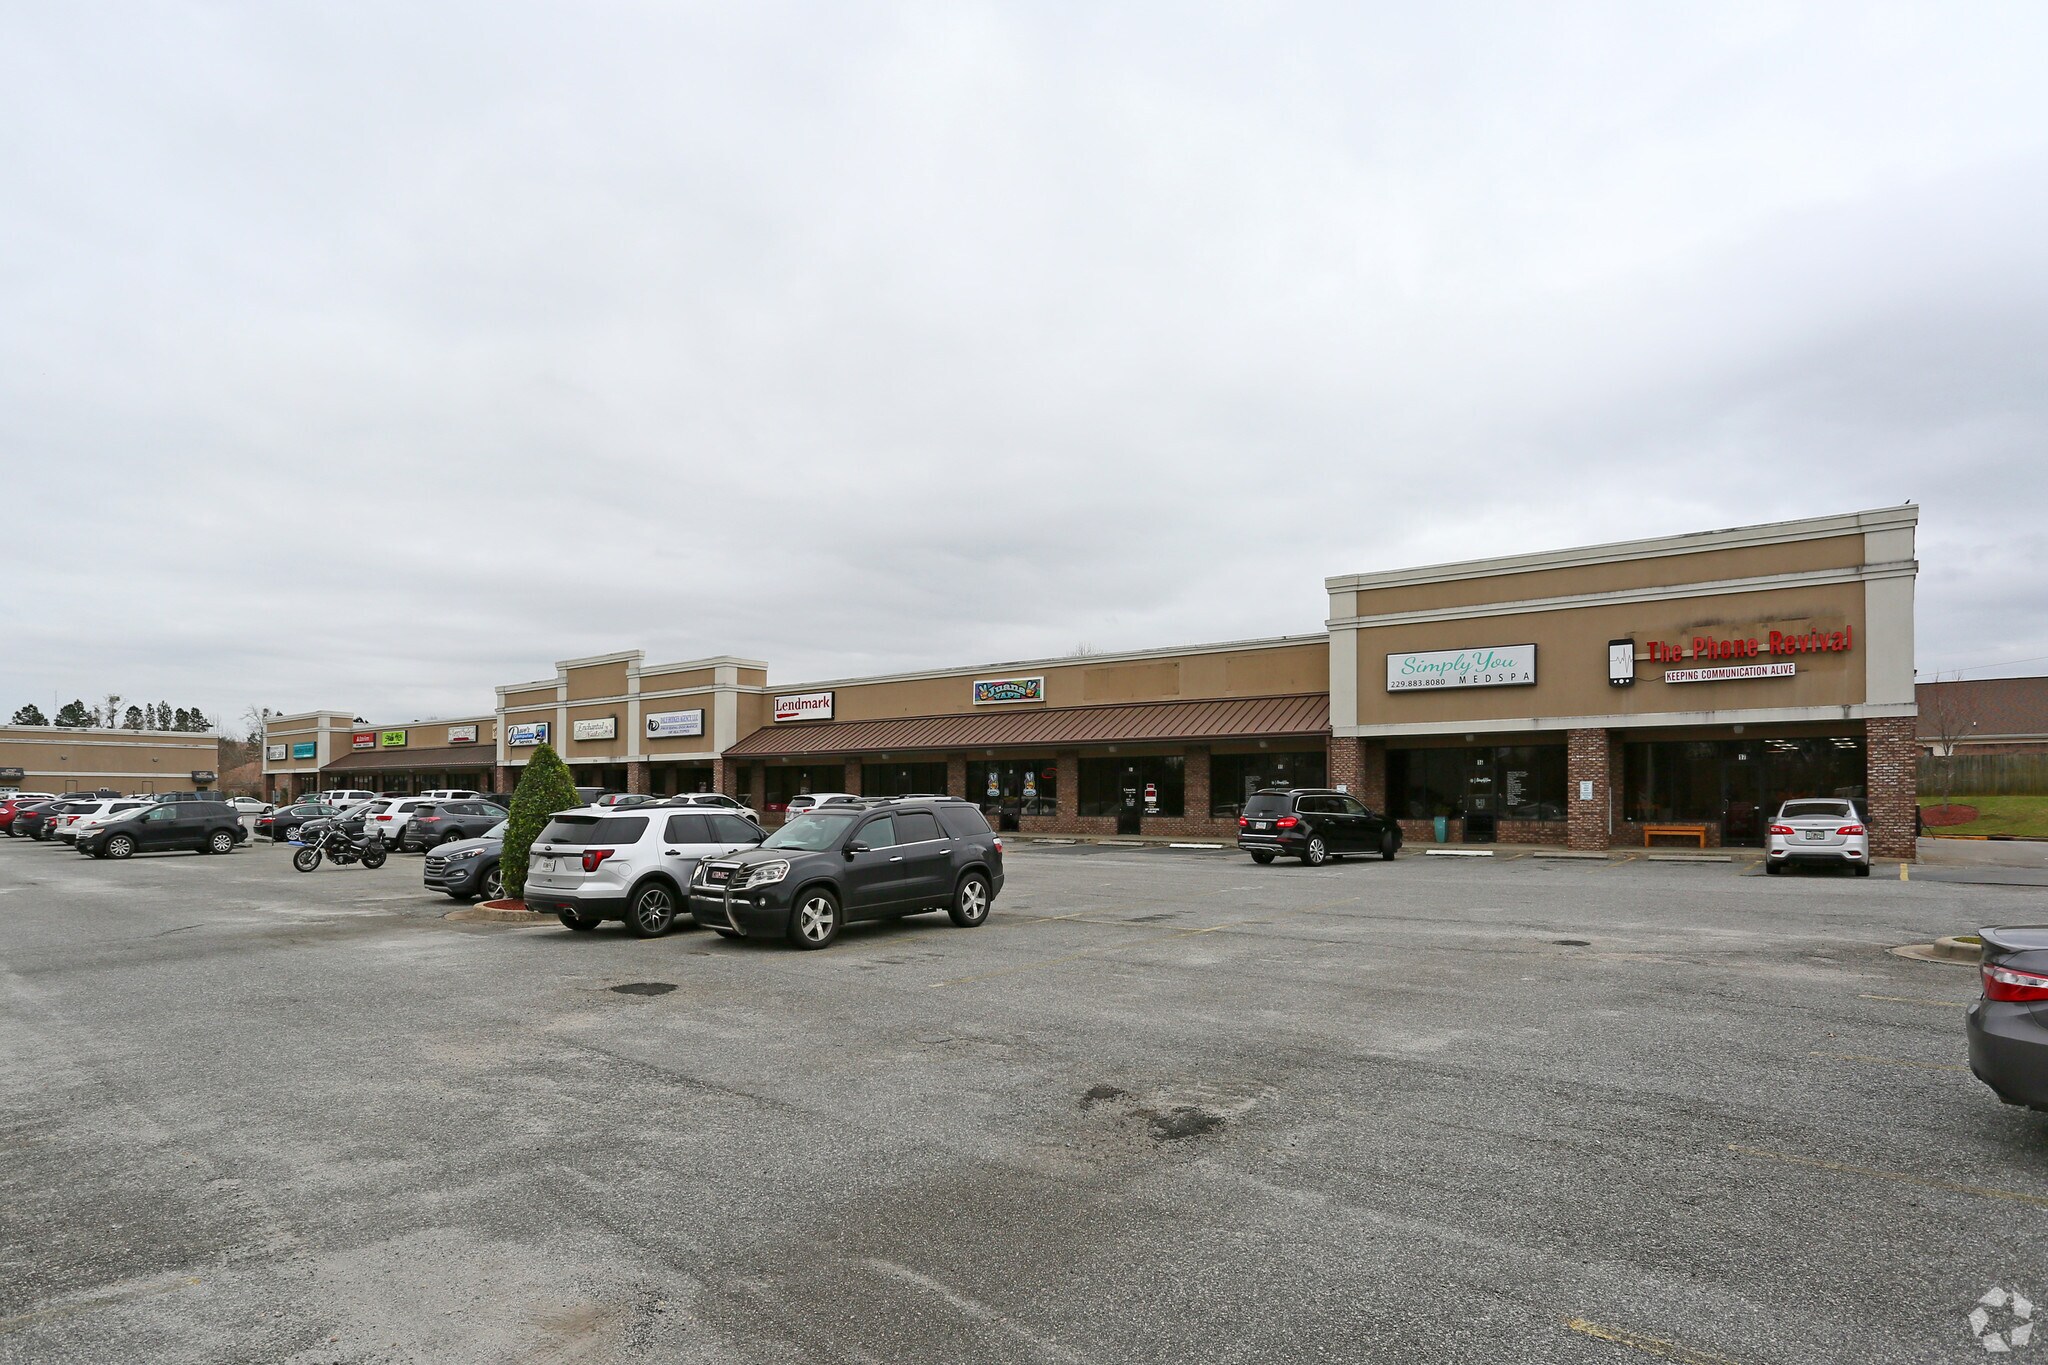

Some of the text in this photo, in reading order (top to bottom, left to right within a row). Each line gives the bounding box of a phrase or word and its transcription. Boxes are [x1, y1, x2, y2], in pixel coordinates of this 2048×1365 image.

[1647, 625, 1853, 663] The Phone Revival
[1401, 651, 1517, 676] Simply You
[1666, 664, 1794, 681] KEEPING COMMUNICATION ALIVE
[1391, 678, 1446, 688] 229.883.8080
[988, 684, 1026, 698] Juana
[999, 691, 1021, 700] VAPE
[775, 695, 830, 711] Lendmark
[711, 871, 729, 880] GMC
